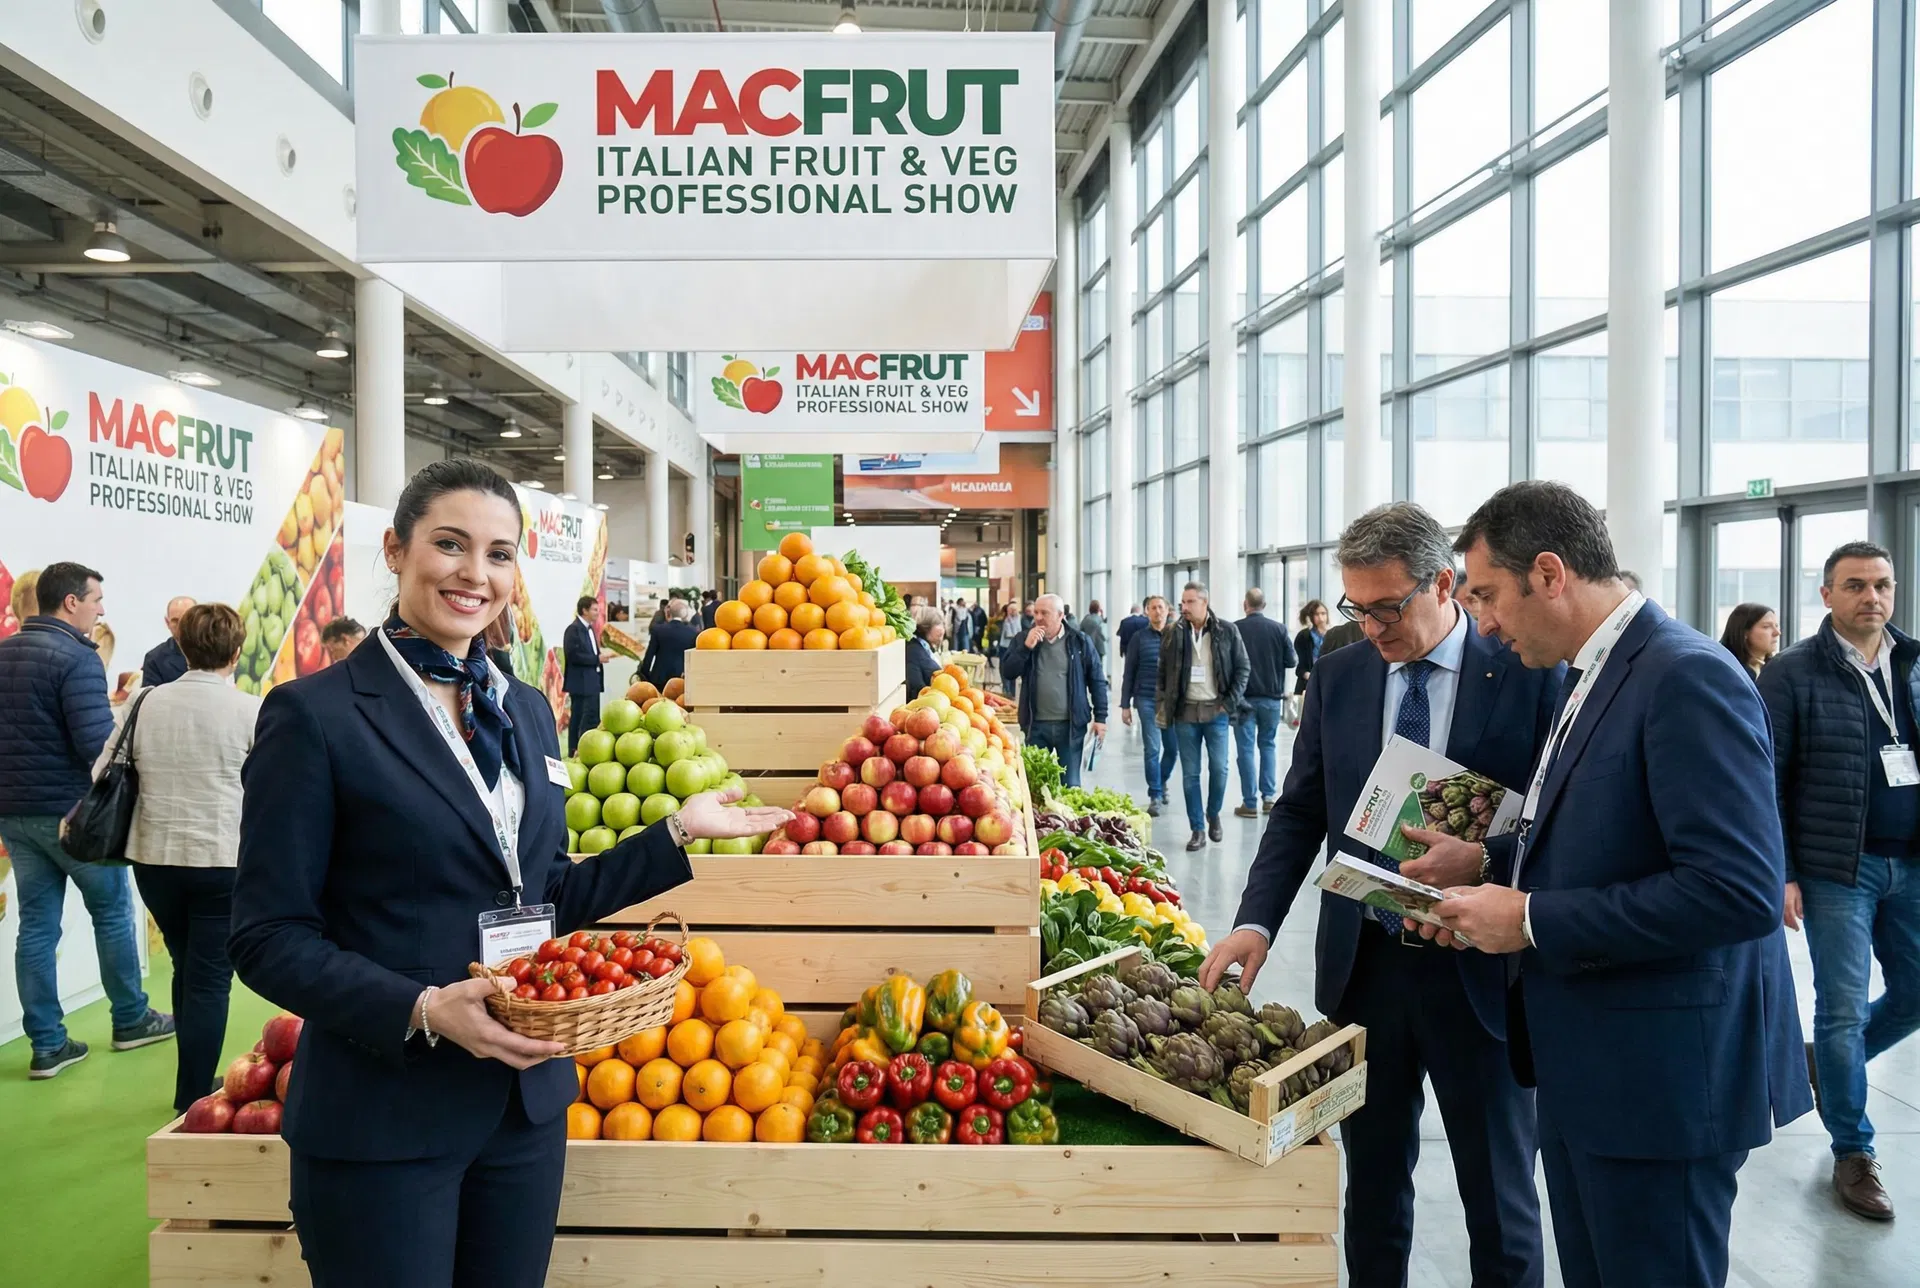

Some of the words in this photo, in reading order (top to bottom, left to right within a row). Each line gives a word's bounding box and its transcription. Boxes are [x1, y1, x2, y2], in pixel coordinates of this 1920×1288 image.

[596, 68, 1019, 137] MACFRUT
[598, 146, 752, 176] ITALIAN
[770, 146, 885, 176] FRUIT
[900, 146, 927, 176] &
[941, 146, 1017, 176] VEG
[598, 184, 892, 214] PROFESSIONAL
[904, 184, 1017, 214] SHOW
[796, 353, 969, 381] MACFRUT
[797, 385, 859, 398] ITALIAN
[866, 385, 914, 398] FRUIT
[920, 385, 931, 398] &
[936, 385, 968, 398] VEG
[797, 401, 916, 413] PROFESSIONAL
[922, 401, 968, 413] SHOW
[89, 391, 253, 473] MACFRUT
[90, 452, 158, 486] ITALIAN
[164, 465, 209, 493] FRUIT
[214, 475, 223, 496] &
[227, 477, 253, 500] VEG
[90, 483, 211, 520] PROFESSIONAL
[215, 501, 253, 525] SHOW
